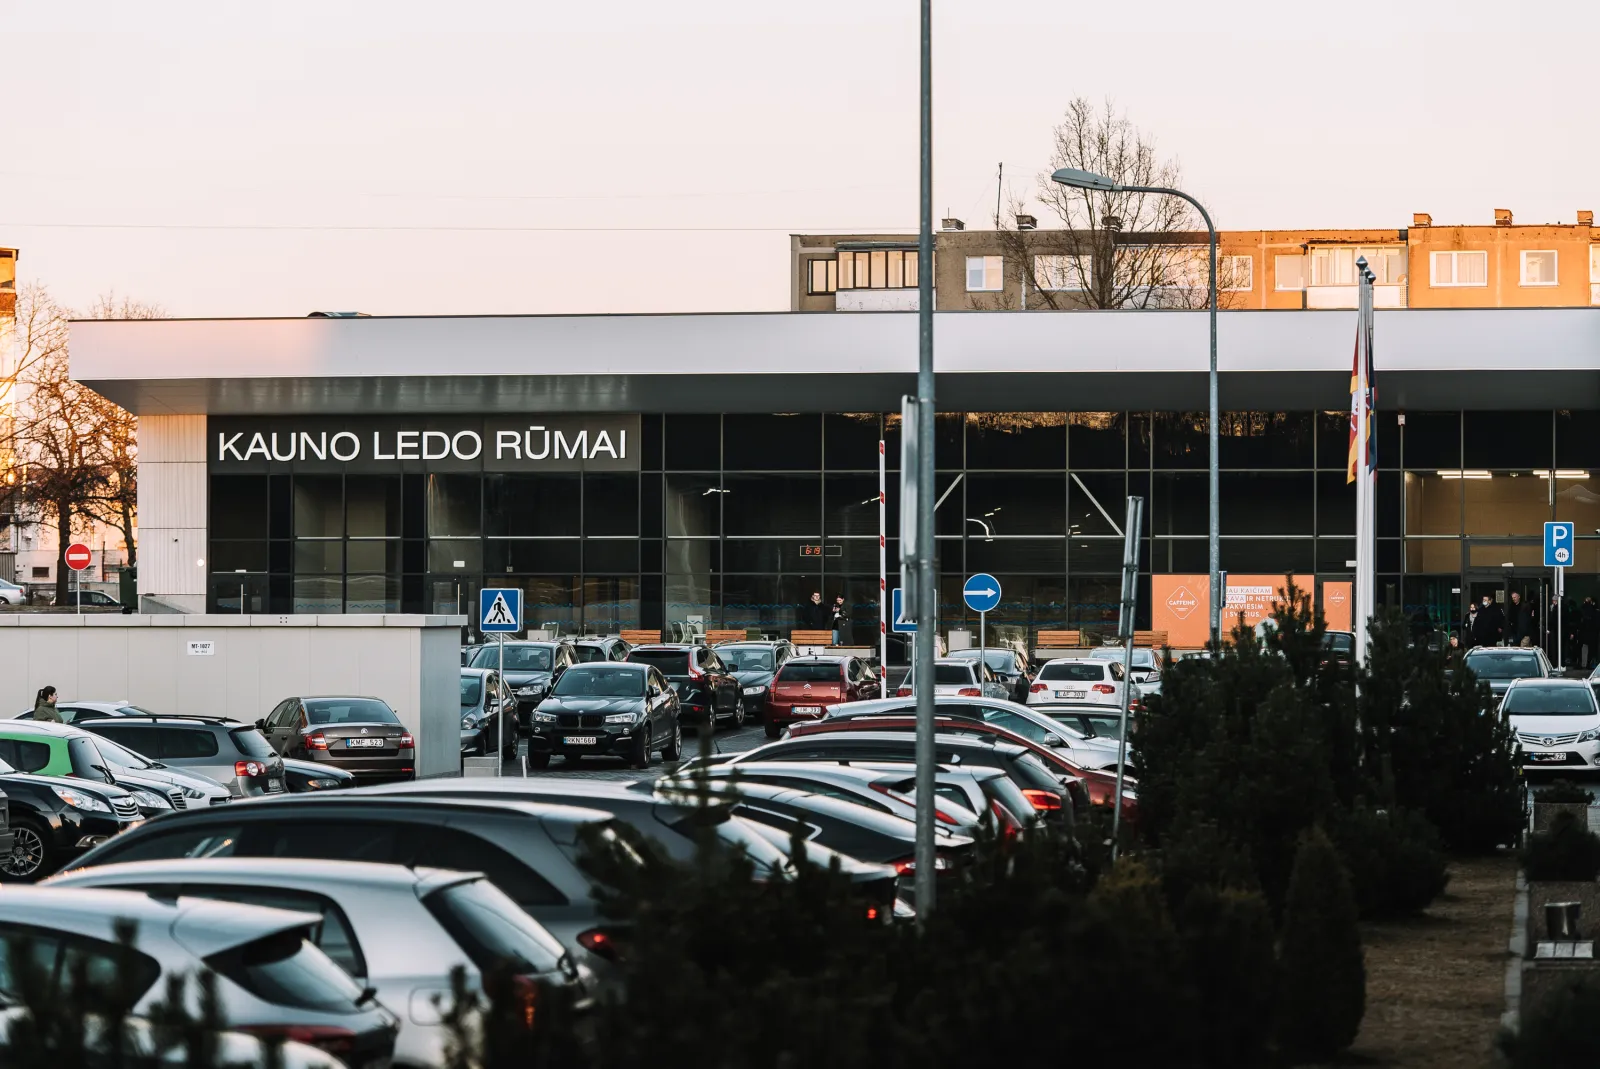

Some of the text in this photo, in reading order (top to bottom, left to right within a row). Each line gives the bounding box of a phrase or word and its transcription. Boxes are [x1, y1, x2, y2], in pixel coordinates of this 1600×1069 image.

[218, 426, 626, 462] KAUNO LEDO RŪMAI
[1552, 525, 1568, 548] P
[1556, 551, 1566, 559] 4h
